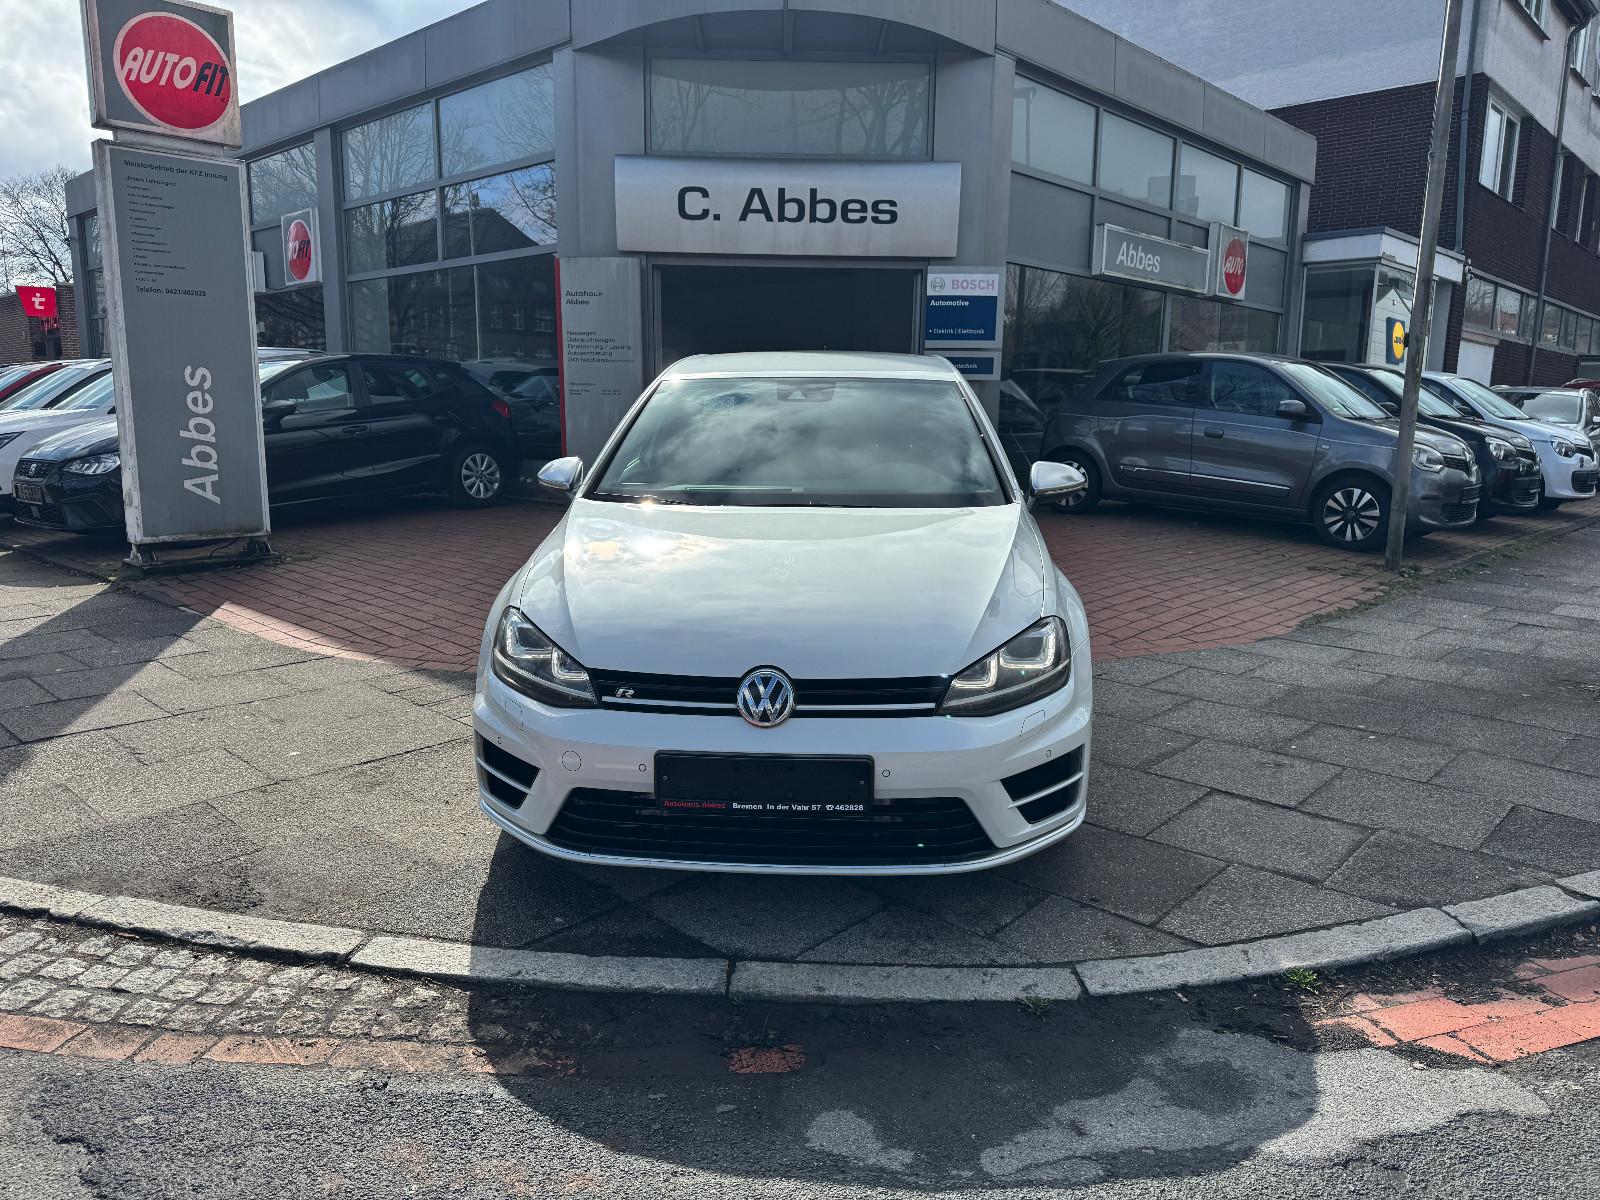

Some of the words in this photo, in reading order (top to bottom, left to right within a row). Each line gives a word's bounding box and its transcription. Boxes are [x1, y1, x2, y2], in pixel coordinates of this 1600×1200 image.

[176, 167, 188, 175] der
[190, 169, 203, 177] KFZ
[677, 186, 721, 221] C.
[738, 187, 898, 224] Abbes
[1116, 241, 1161, 273] Abbes
[1224, 256, 1244, 276] AUTO
[951, 279, 995, 290] BOSCH
[929, 299, 969, 307] Automotive
[179, 365, 221, 505] Abbes
[732, 802, 763, 810] Bremen
[791, 803, 810, 811] Vahr
